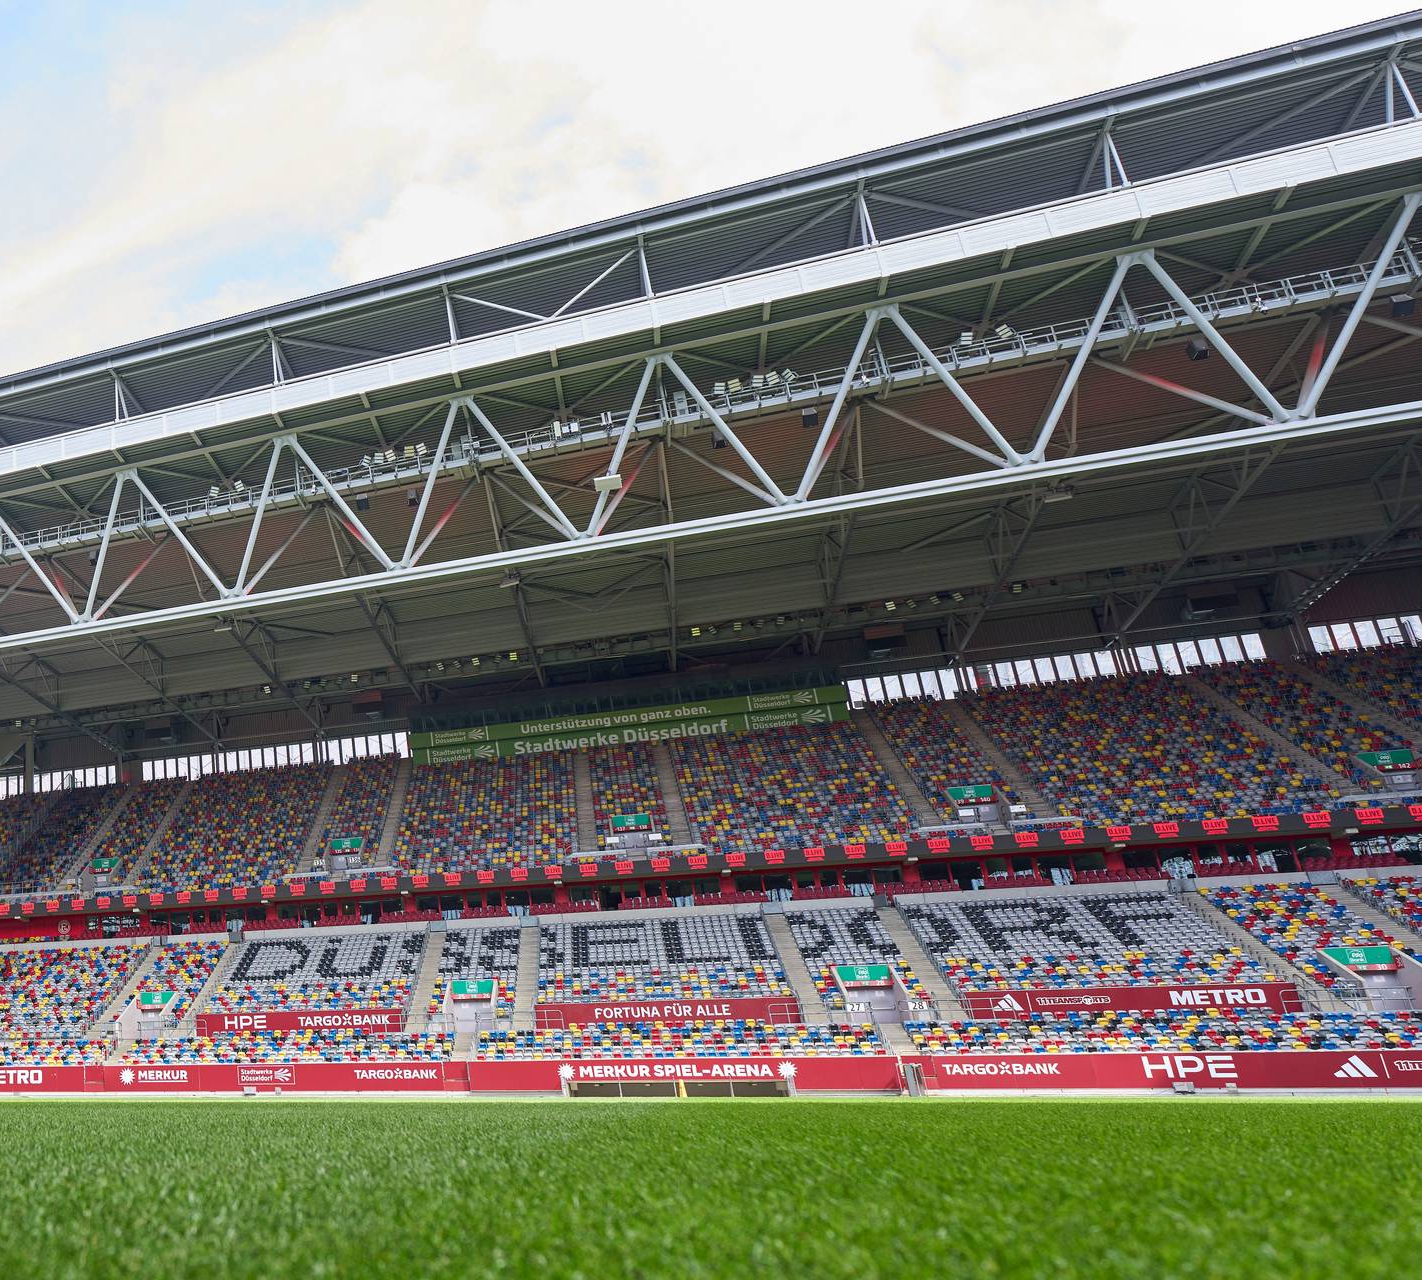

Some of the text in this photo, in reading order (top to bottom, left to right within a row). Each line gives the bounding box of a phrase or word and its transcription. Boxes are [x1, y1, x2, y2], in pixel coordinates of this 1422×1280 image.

[752, 693, 791, 702] Stadtwerke
[753, 700, 792, 709] Düsseldorf
[520, 705, 711, 734] Unterstützung von ganz oben.
[751, 711, 798, 723] Stadtwerke
[752, 719, 799, 730] Düsseldorf
[434, 731, 466, 739] Stadtwerke
[435, 736, 467, 744] Düsseldorf
[513, 719, 728, 755] Stadtwerke Düsseldorf
[432, 748, 471, 757] Stadtwerke
[433, 755, 472, 764] Düsseldorf
[1305, 812, 1328, 822] D.LIVE
[1358, 809, 1382, 819] D.LIVE
[1169, 988, 1266, 1006] METRO
[594, 1003, 731, 1019] FORTUNA FÜR ALLE
[912, 1002, 924, 1010] 28
[224, 1015, 267, 1029] HPE
[579, 1064, 774, 1078] MERKUR SPIEL-ARENA
[1141, 1056, 1238, 1078] HPE
[138, 1070, 188, 1080] MERKUR
